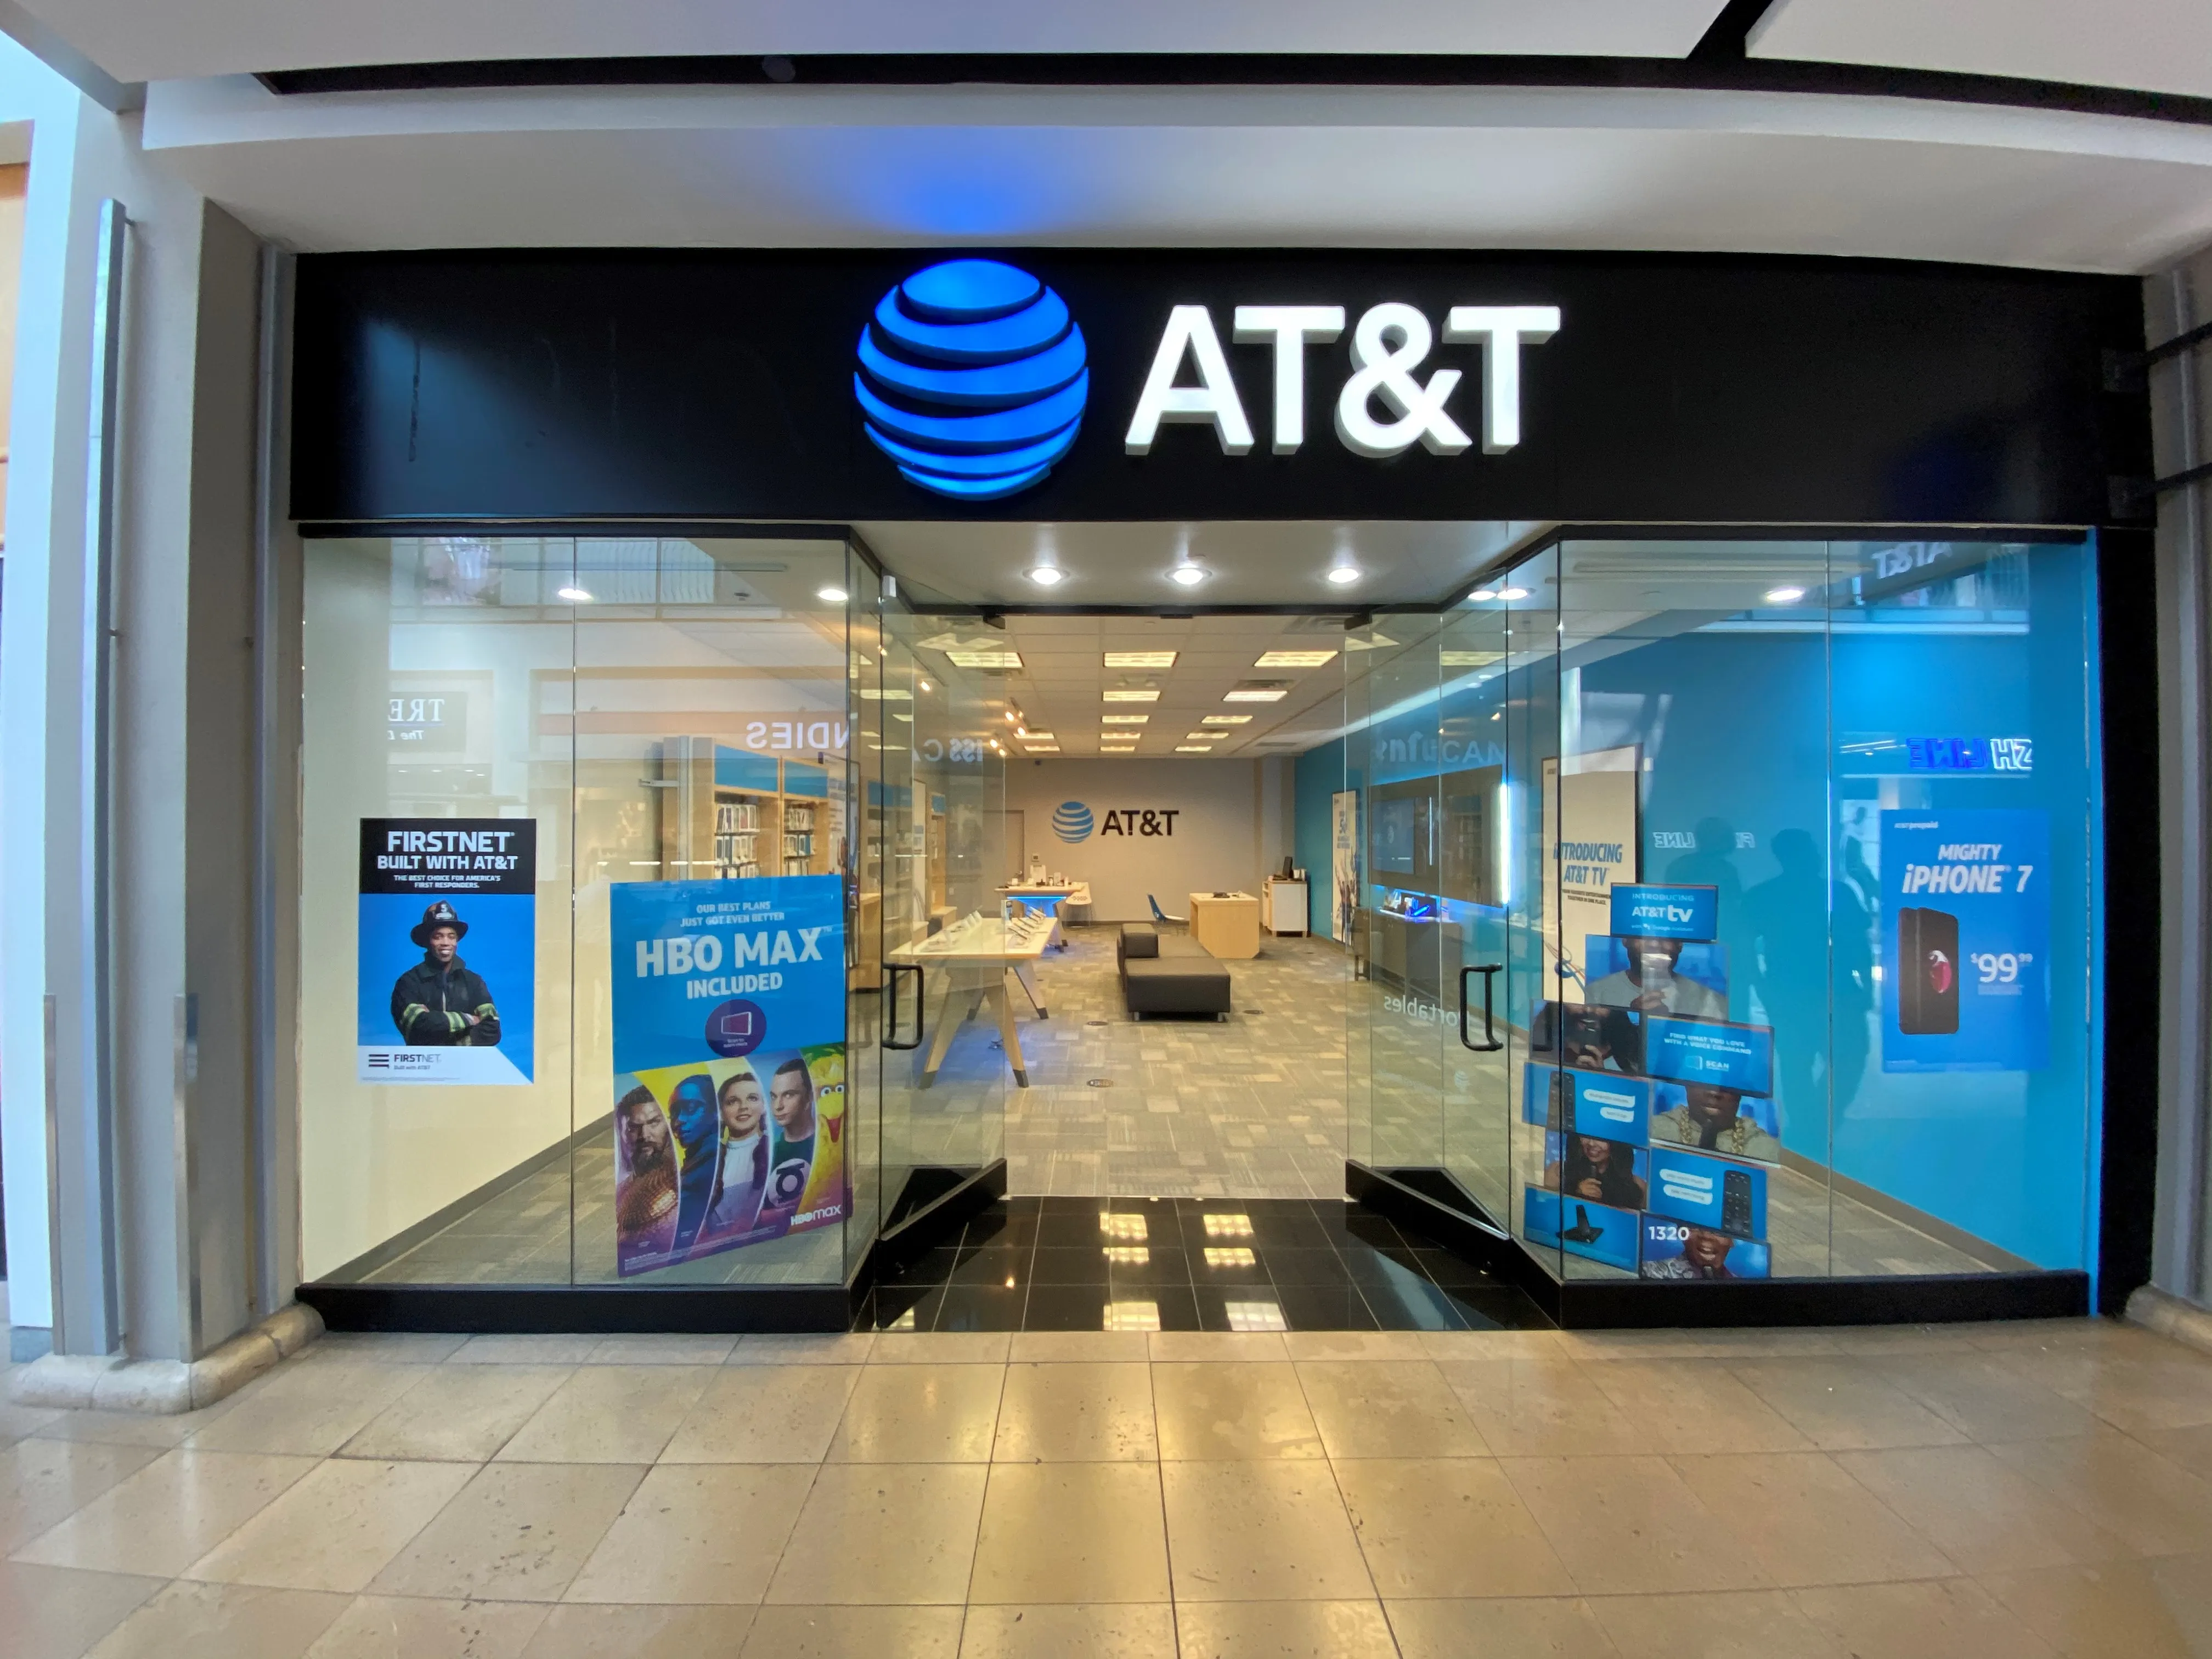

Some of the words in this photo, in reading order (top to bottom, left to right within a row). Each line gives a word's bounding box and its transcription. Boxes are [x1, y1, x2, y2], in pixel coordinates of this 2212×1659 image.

[1124, 302, 1561, 457] AT&T
[1101, 810, 1180, 837] AT&T
[387, 831, 511, 852] FIRSTNET
[1553, 842, 1623, 863] ITRODUCING
[1938, 844, 2002, 861] MIGHTY
[377, 855, 422, 870] BUILT
[426, 855, 470, 870] WITH
[473, 855, 519, 870] AT&T
[1564, 865, 1590, 885] AT&T
[1592, 866, 1607, 886] TV
[1901, 864, 2004, 894] iPHONE
[2016, 865, 2034, 894] 7
[1632, 893, 1695, 901] INTRODUCING
[696, 904, 715, 913] OUR
[718, 902, 740, 912] BEST
[743, 901, 771, 911] PLANS
[1632, 906, 1667, 918] AT&T
[1667, 904, 1694, 923] tv
[680, 917, 702, 927] JUST
[706, 916, 725, 926] GOT
[726, 915, 750, 924] EVEN
[752, 912, 785, 922] BETTER
[635, 934, 723, 978] HBO
[734, 927, 823, 969] MAX
[686, 972, 783, 1000] INCLUDED
[394, 1054, 442, 1063] FIRSTNET
[1706, 1060, 1730, 1069] SCAN
[1648, 1226, 1690, 1241] 1320
